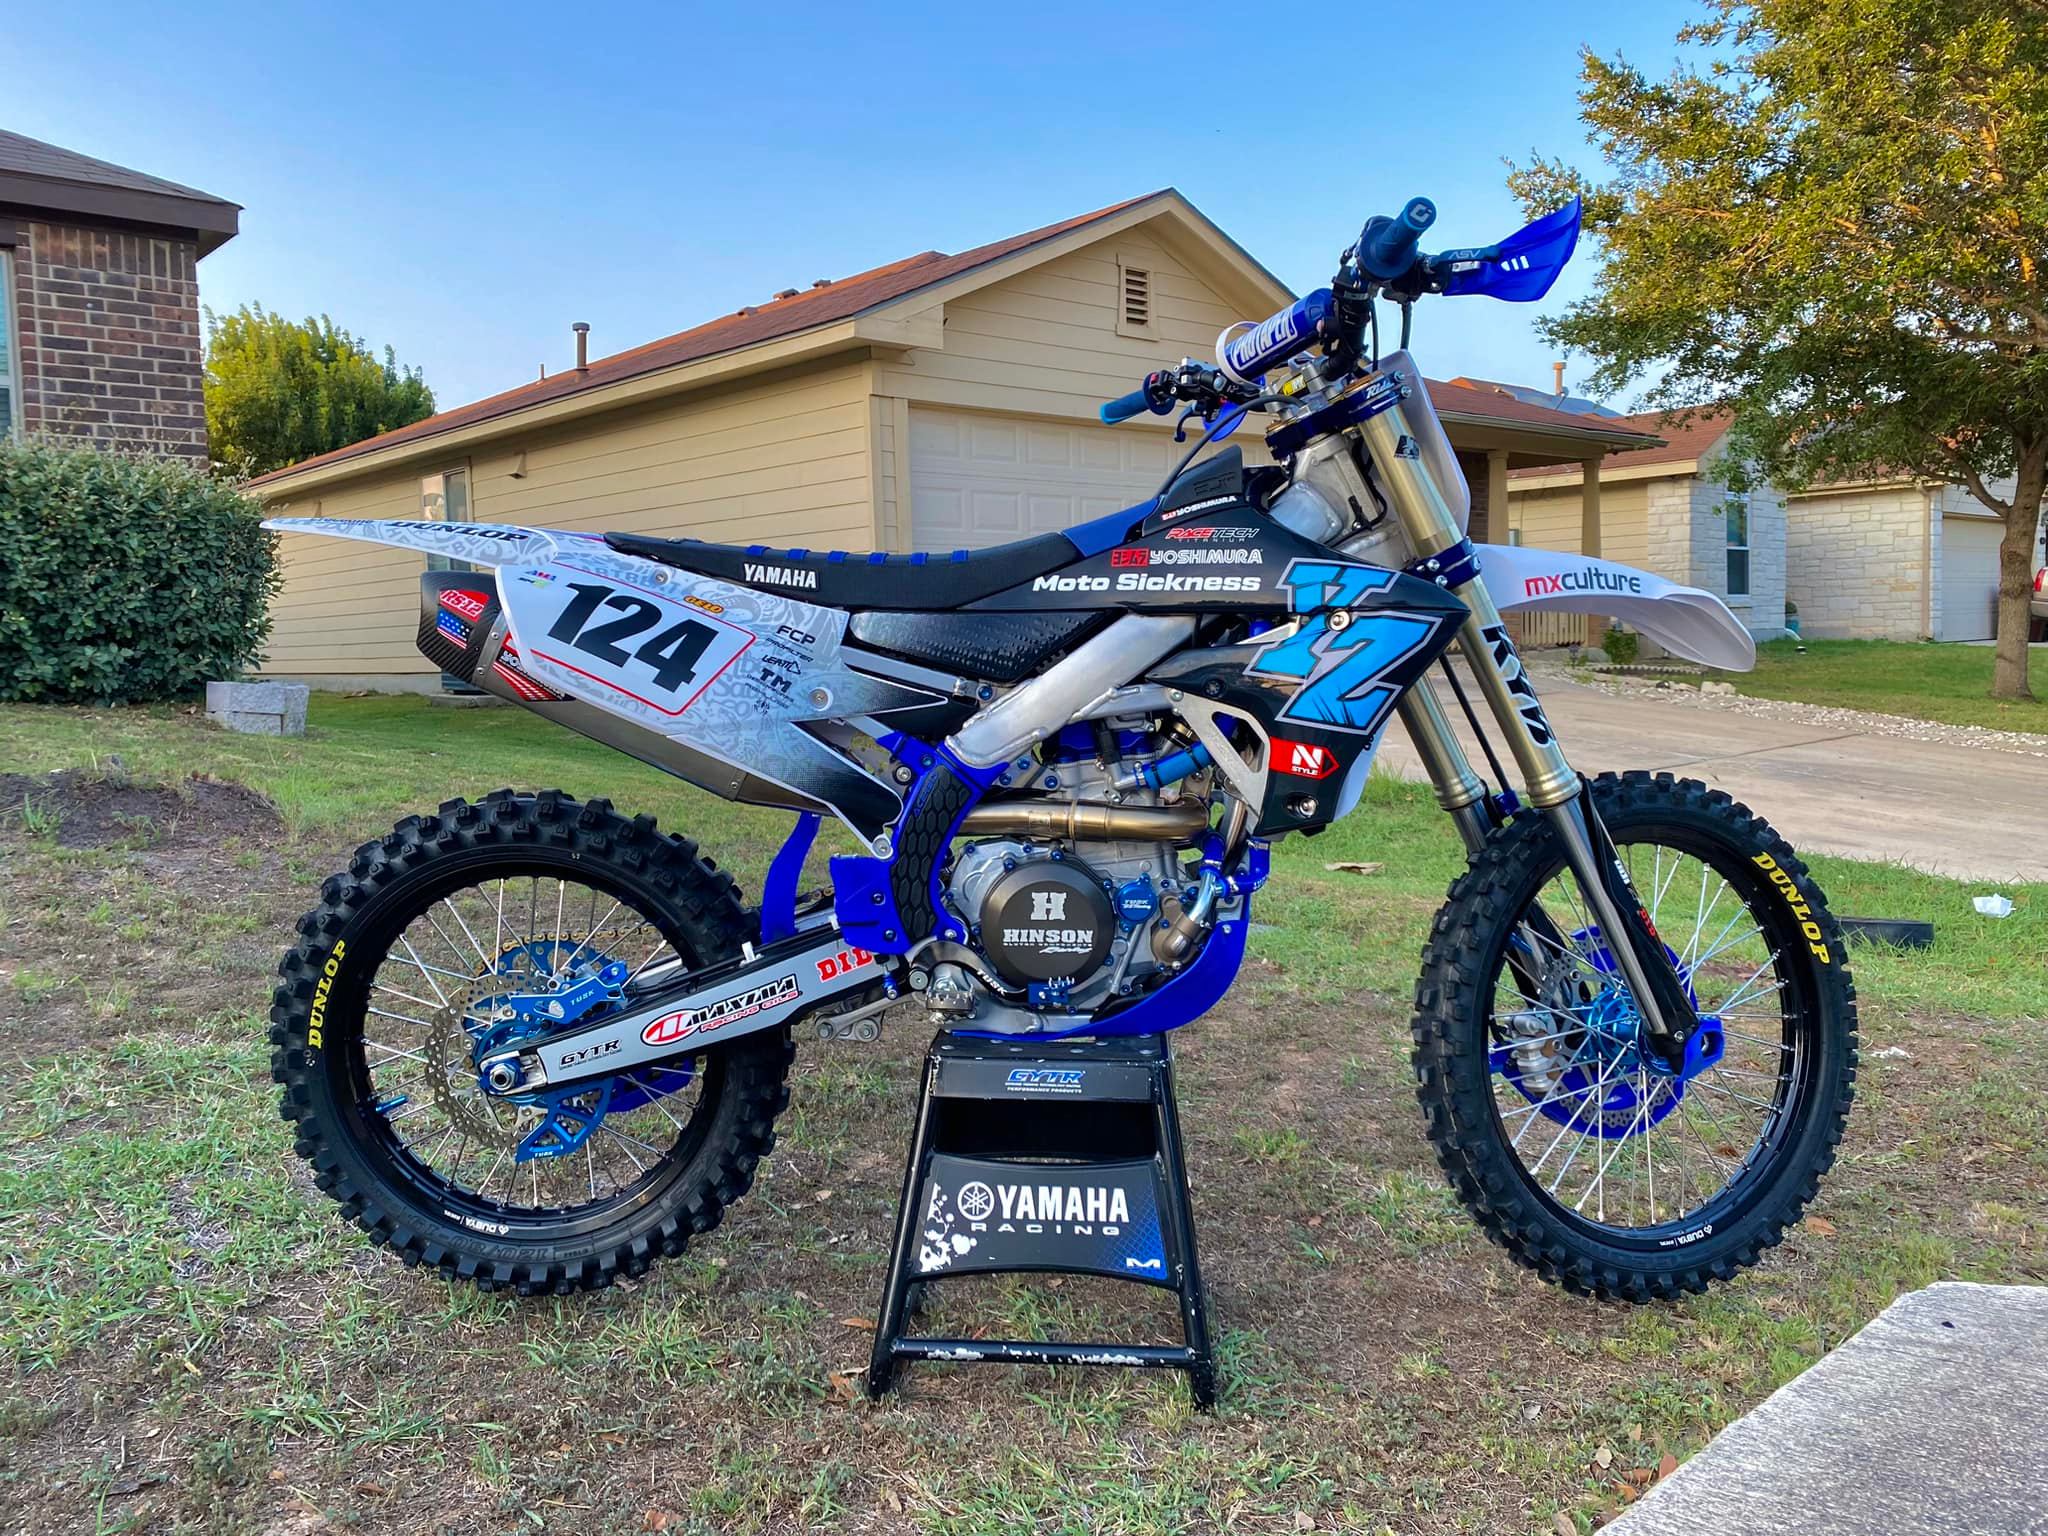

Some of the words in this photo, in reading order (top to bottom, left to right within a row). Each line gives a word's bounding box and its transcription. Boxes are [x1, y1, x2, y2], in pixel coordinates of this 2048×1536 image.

[387, 520, 530, 542] DUNLOP
[1149, 549, 1264, 565] YOSHIMURA
[743, 563, 817, 589] YAMAHA
[1032, 573, 1110, 592] Moto
[1115, 572, 1262, 592] Sickness
[1524, 566, 1642, 597] mxculture
[547, 582, 719, 693] 124
[776, 624, 816, 645] FCP
[759, 667, 793, 693] TM
[1291, 766, 1319, 776] STYLE
[1751, 851, 1831, 964] DUNLOP
[1002, 928, 1094, 943] HINSON
[976, 968, 1008, 997] TUSK
[308, 939, 346, 1049] DUNLOP
[570, 989, 595, 1006] TUSK
[700, 1004, 760, 1033] RACING
[761, 990, 799, 1011] OILS
[560, 1040, 621, 1066] GYTR
[1007, 1068, 1084, 1084] GYTR
[996, 1184, 1130, 1223] YAMAHA
[464, 1215, 497, 1234] DUBYA
[971, 1222, 1120, 1236] RACING
[1677, 1229, 1705, 1244] DUBYA
